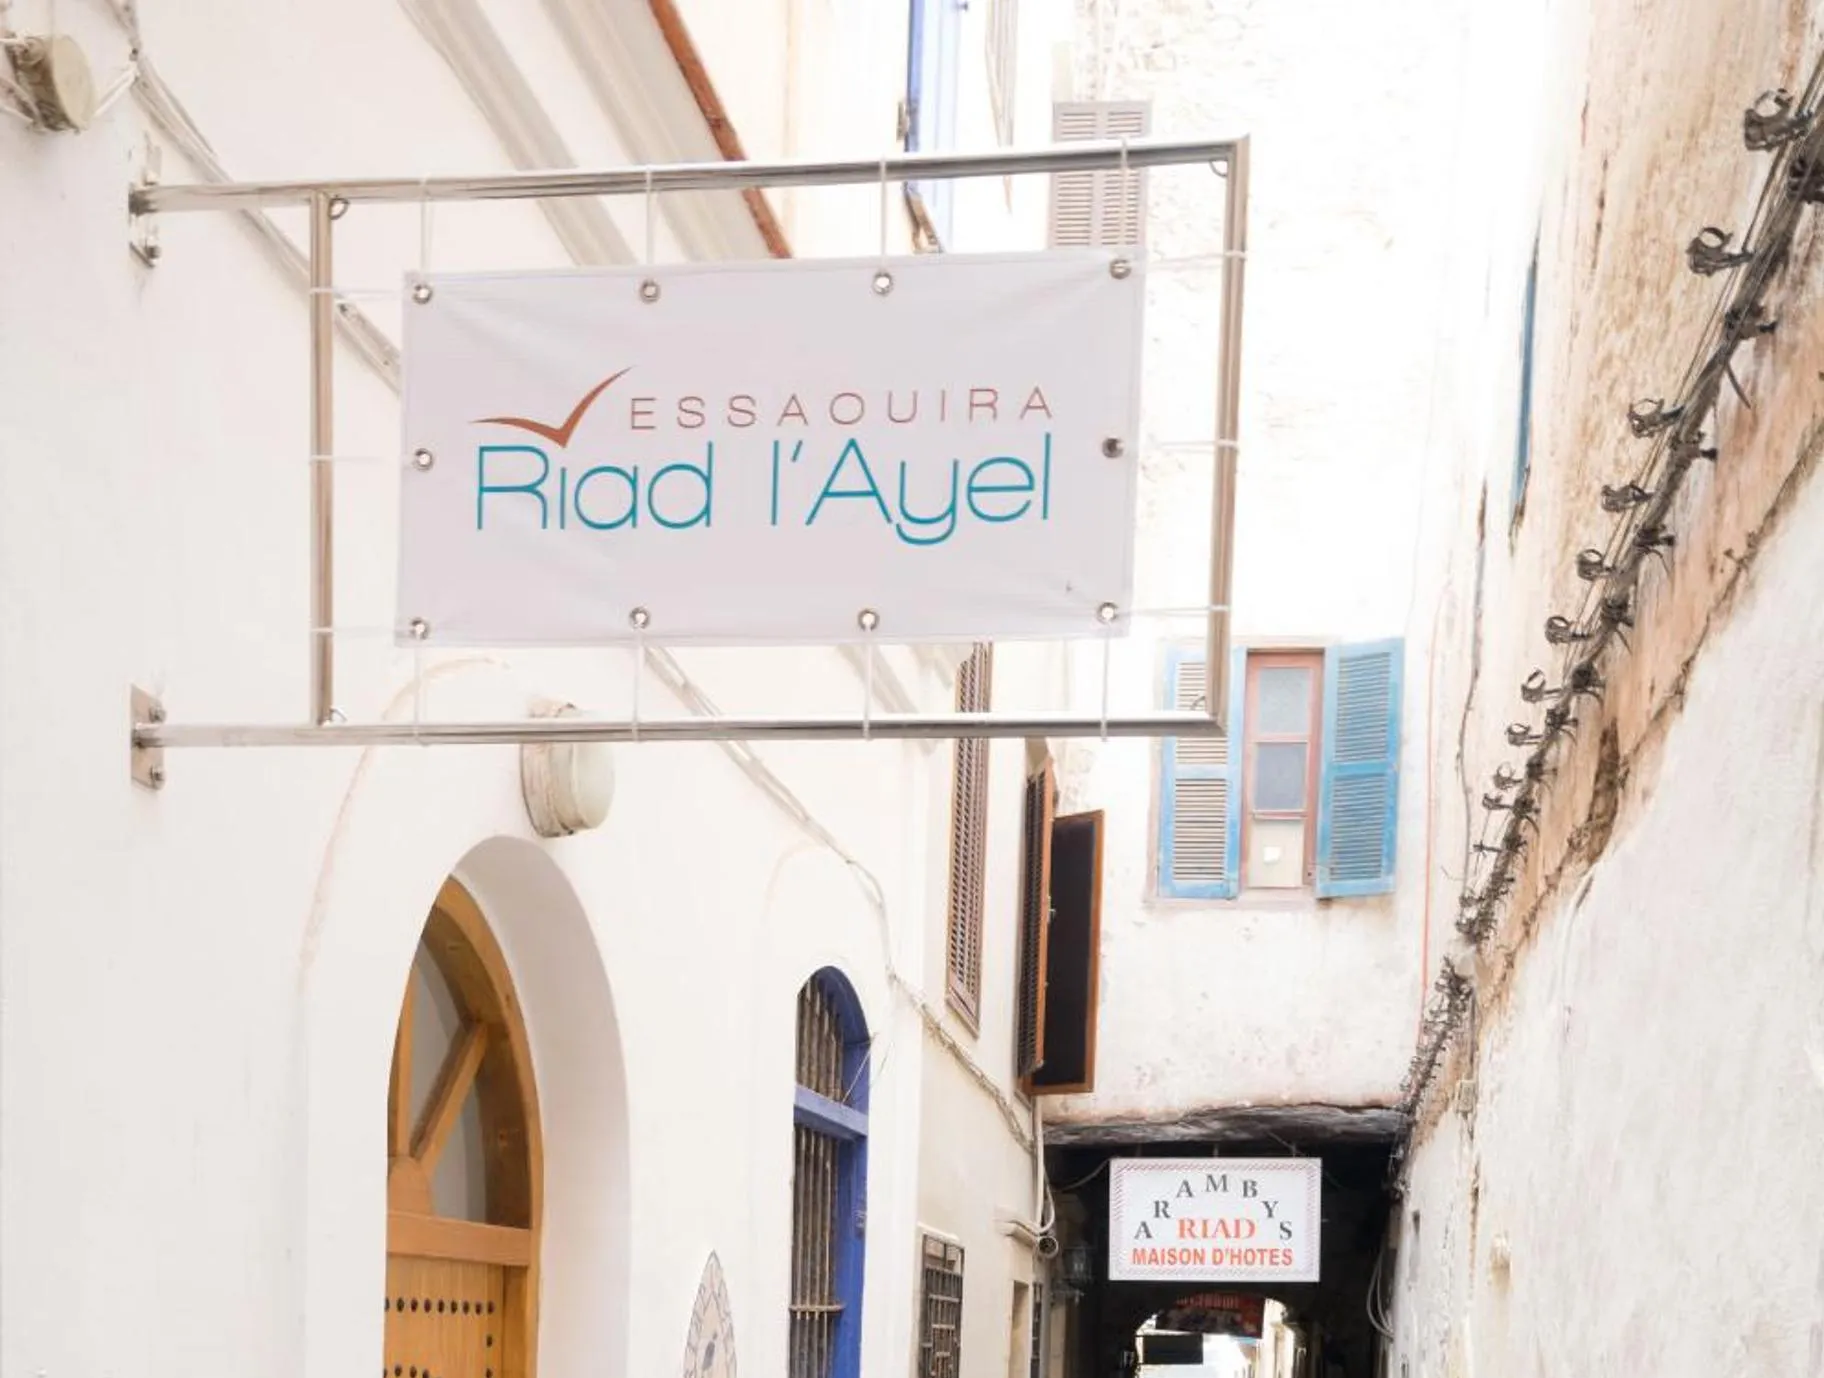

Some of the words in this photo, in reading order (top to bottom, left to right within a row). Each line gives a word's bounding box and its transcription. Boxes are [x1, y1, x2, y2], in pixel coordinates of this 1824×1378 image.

[629, 386, 1053, 431] ESSAOUIRA
[476, 440, 715, 532] Riad
[770, 431, 1053, 547] l'Ayel
[1133, 1173, 1294, 1241] ARAMBYS
[1176, 1217, 1257, 1240] RIAD
[1131, 1247, 1206, 1266] MAISON
[1211, 1247, 1294, 1267] D'HOTES
